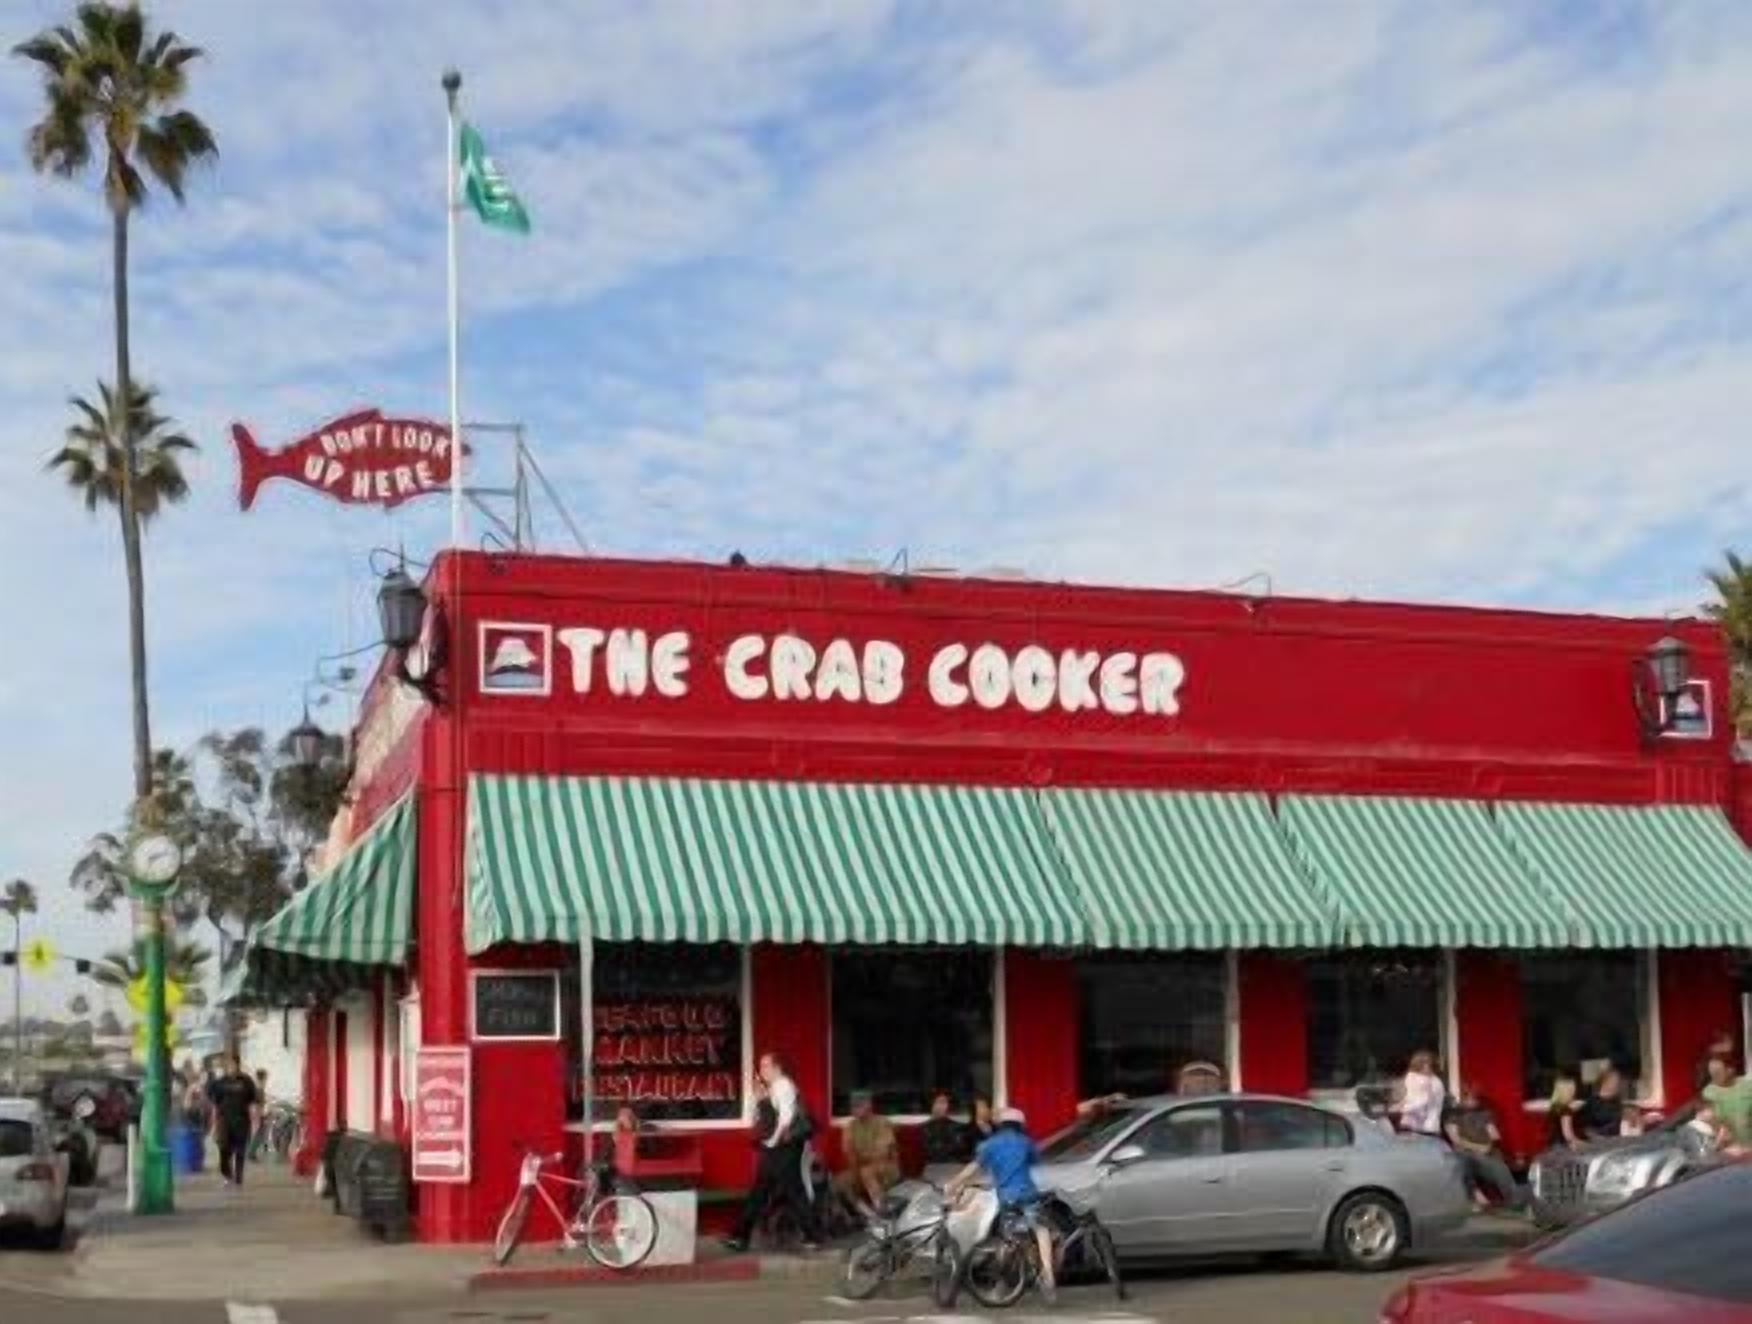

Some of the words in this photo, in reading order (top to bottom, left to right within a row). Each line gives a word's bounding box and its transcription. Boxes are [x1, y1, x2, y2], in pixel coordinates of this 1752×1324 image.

[391, 425, 452, 458] LOOK
[303, 454, 345, 487] UP
[351, 460, 434, 498] HERE
[557, 627, 690, 697] THE
[724, 634, 904, 704] CRAB
[928, 642, 1184, 716] COOKER
